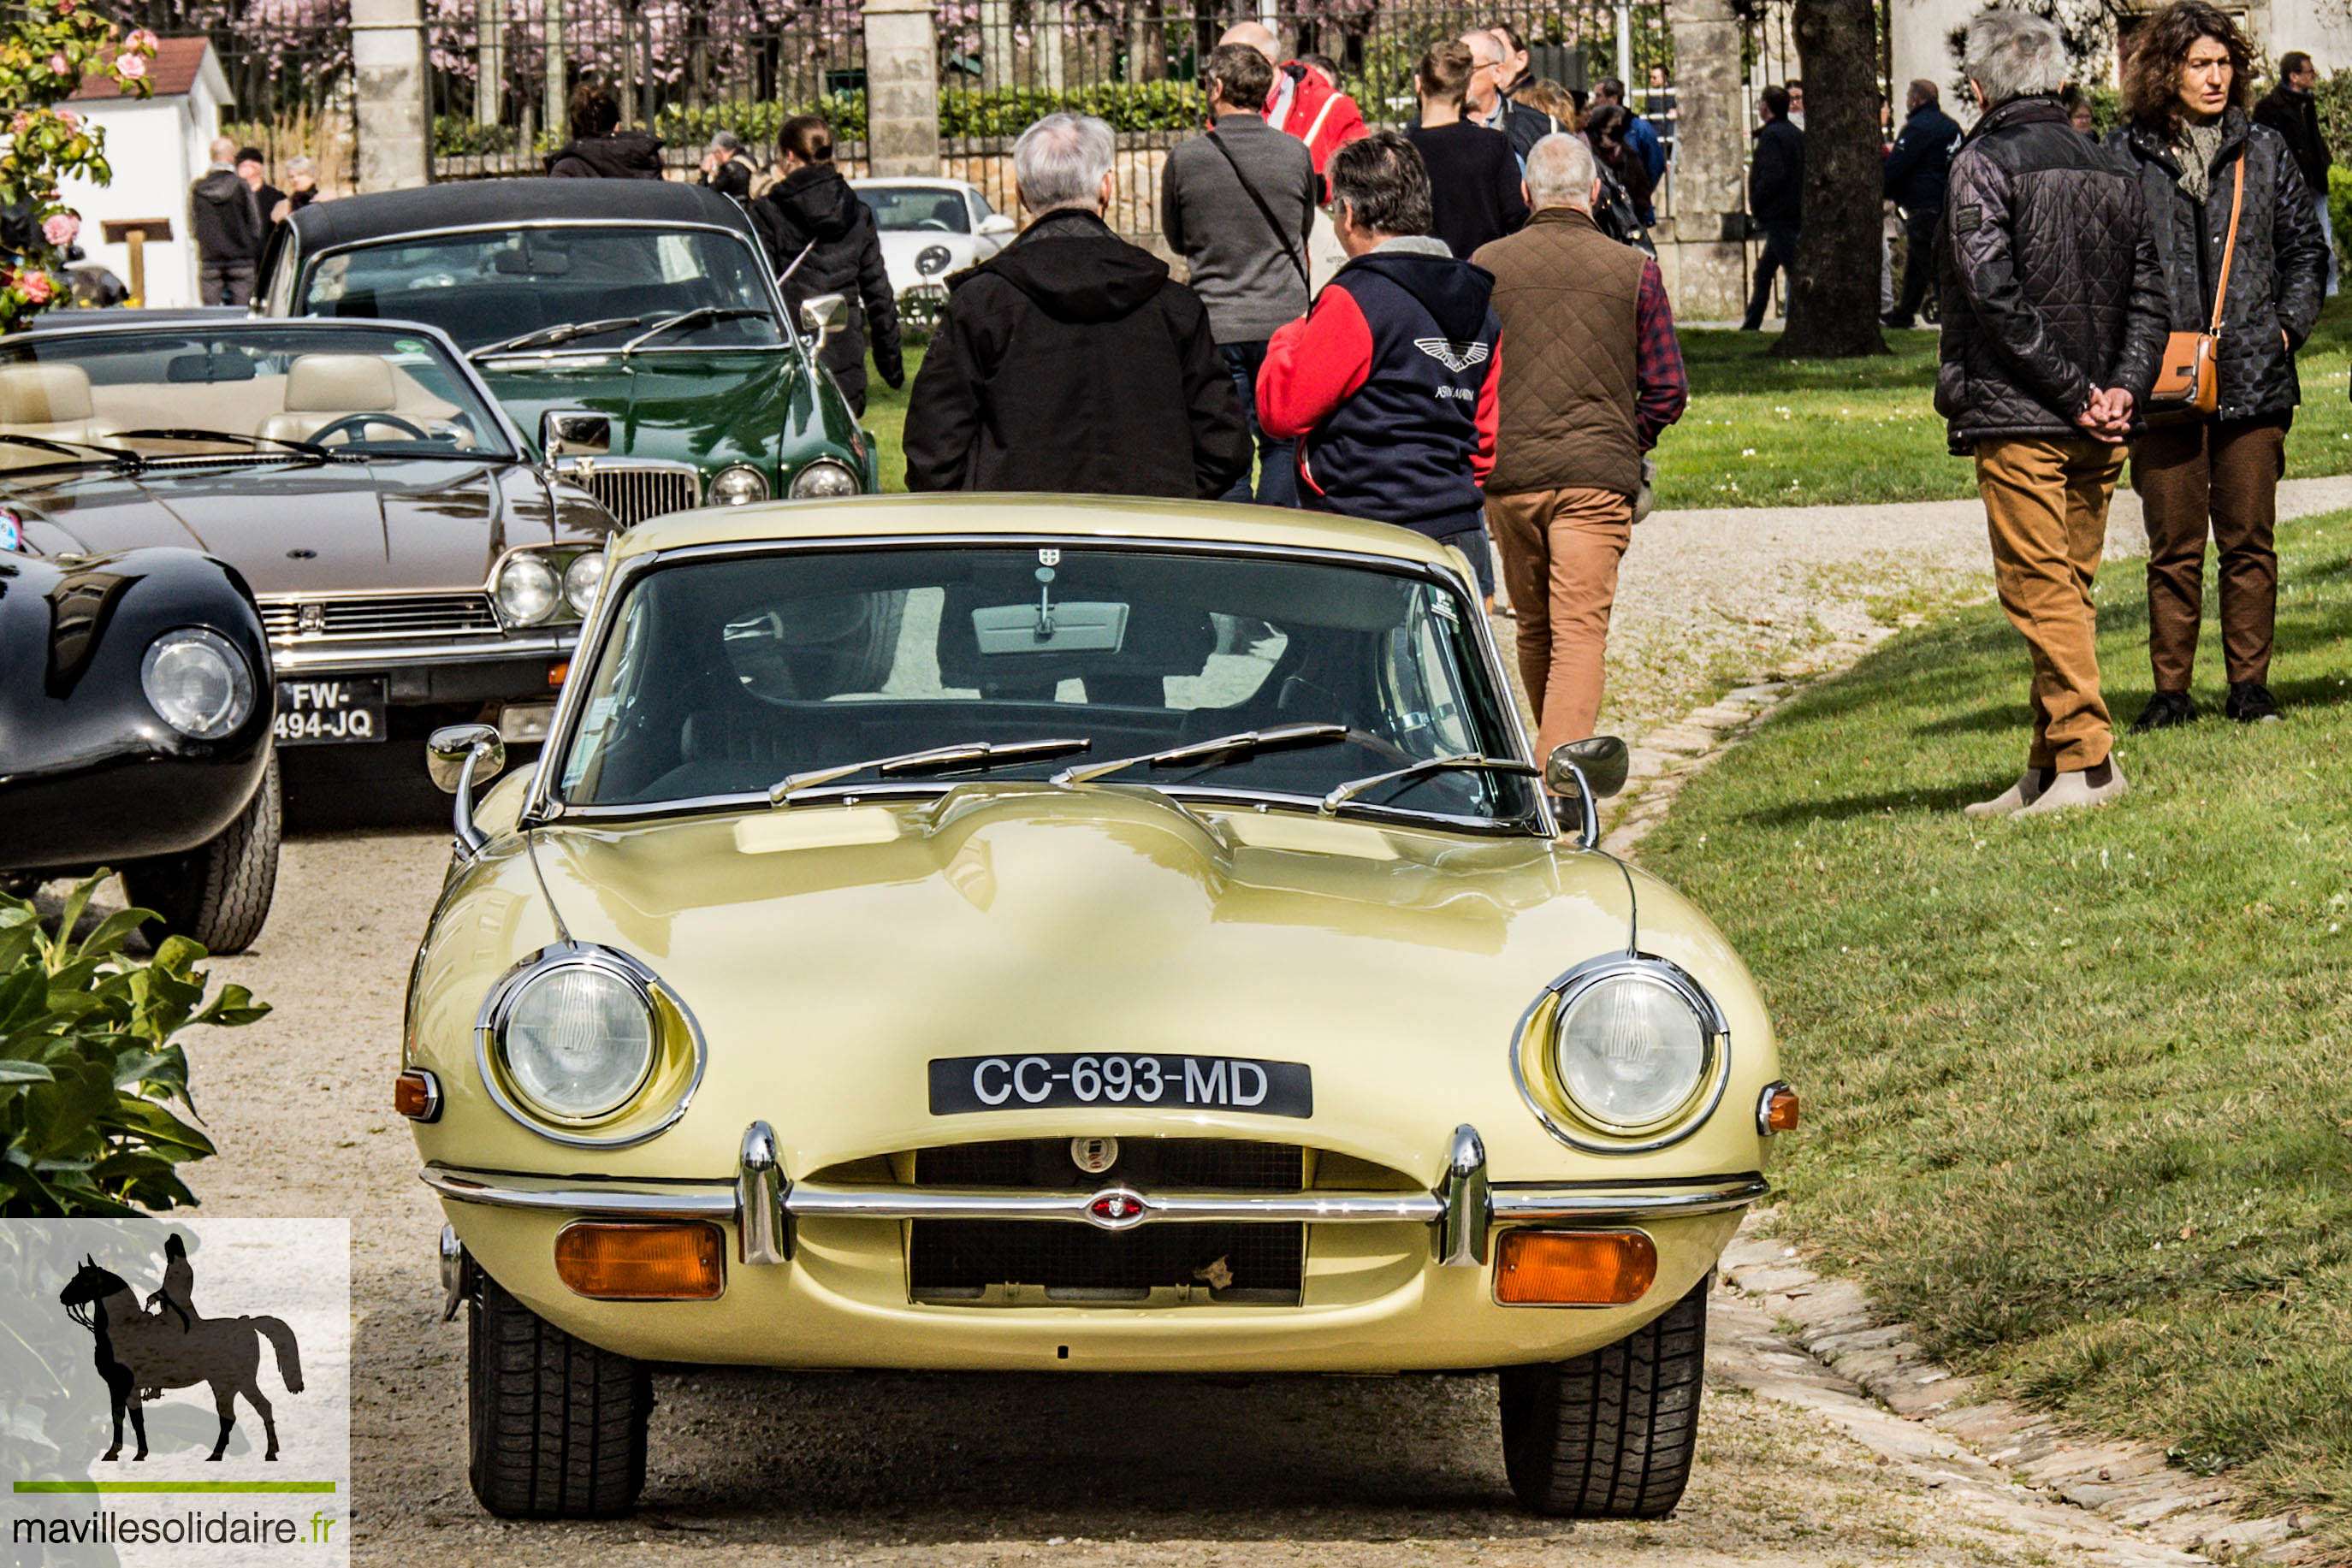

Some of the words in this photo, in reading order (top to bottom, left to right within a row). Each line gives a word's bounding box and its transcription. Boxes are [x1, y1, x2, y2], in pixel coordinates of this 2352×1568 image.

[293, 682, 350, 710] FW-
[274, 709, 373, 739] 494-JQ
[973, 1056, 1268, 1107] CC-693-MD
